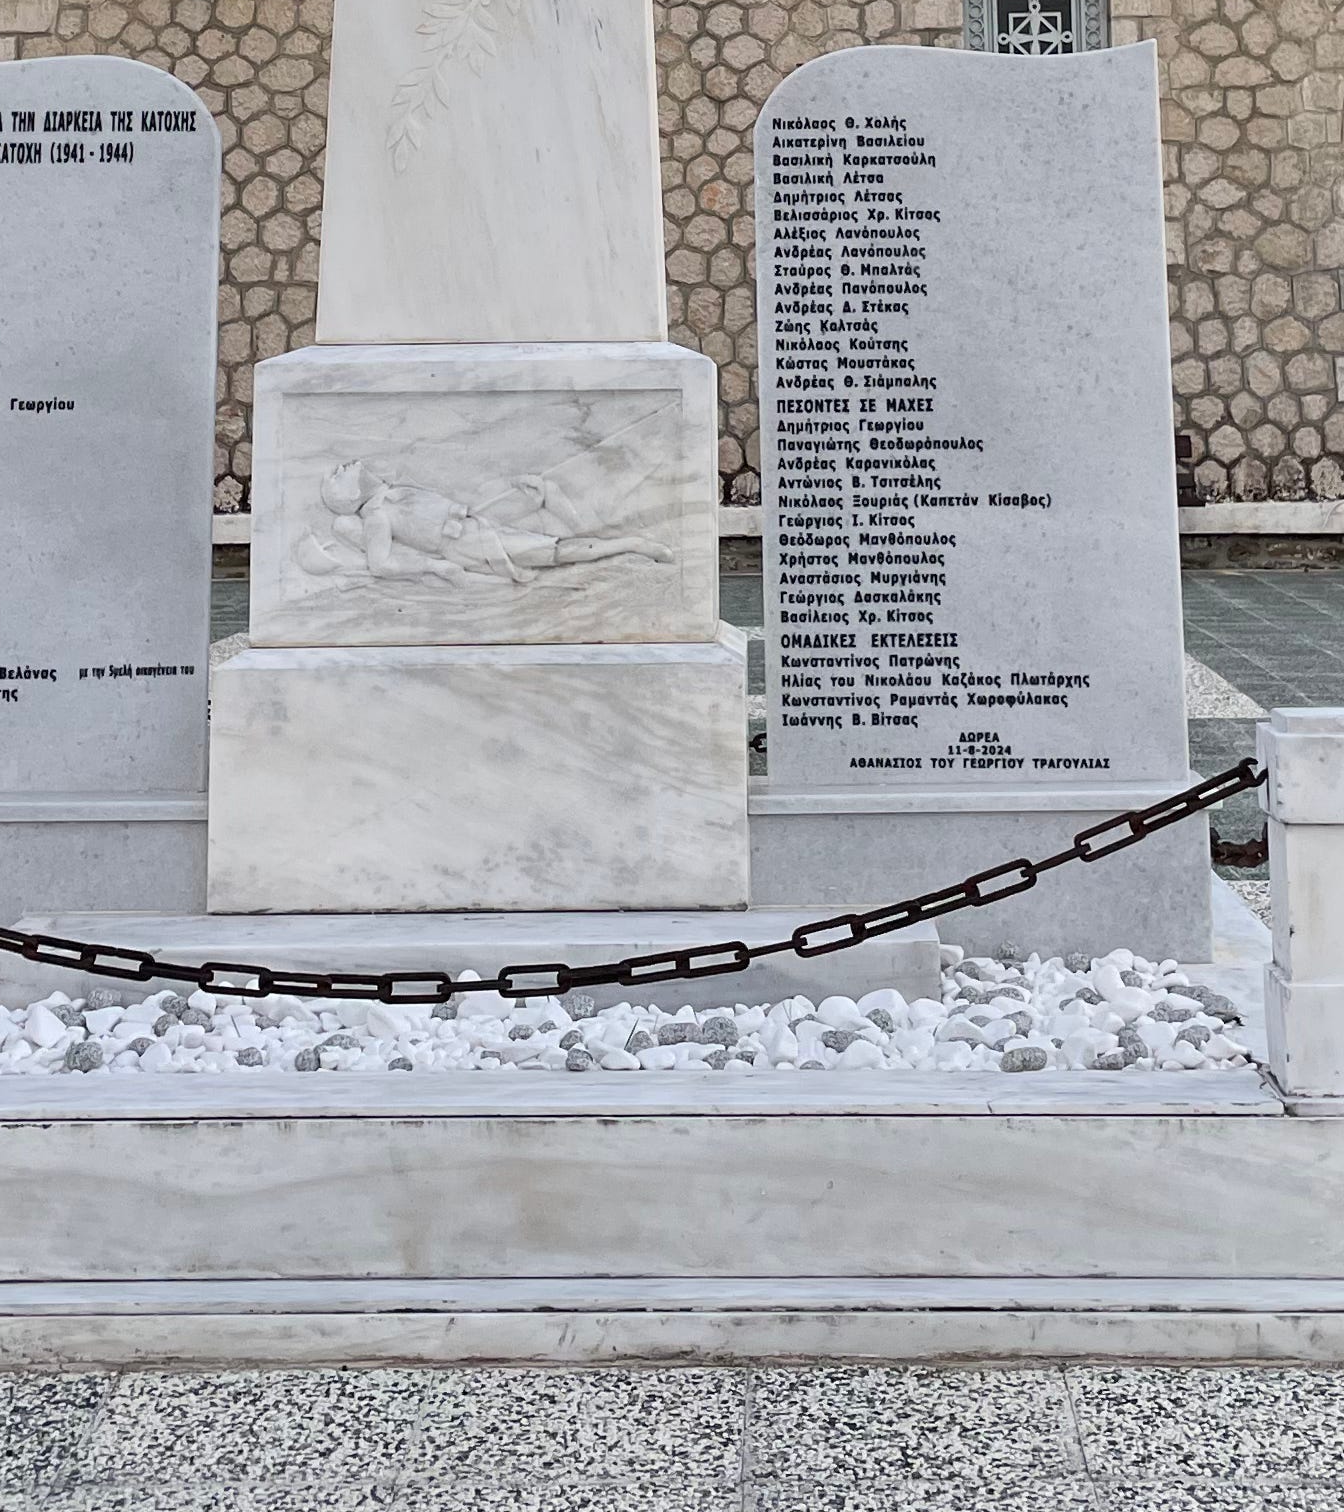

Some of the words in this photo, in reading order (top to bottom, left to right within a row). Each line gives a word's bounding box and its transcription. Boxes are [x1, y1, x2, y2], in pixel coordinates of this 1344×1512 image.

[11, 111, 36, 132] ΤΗΝ
[43, 110, 103, 133] ΔΙΑΡΚΕΙΑ
[110, 110, 134, 132] ΤΗΣ
[141, 110, 197, 133] ΚΑΤΟΧΗΣ
[772, 134, 847, 151] Αικατερίνη
[856, 133, 925, 148] Βασιλείου
[50, 141, 85, 164] (1941
[99, 141, 134, 164] 1944)
[772, 152, 833, 169] Βασιλική
[773, 170, 834, 187] Βασιλική
[773, 189, 845, 206] Δημήτριος
[775, 337, 840, 354] Νικόλαος
[849, 336, 909, 353] Κούτσης
[776, 355, 828, 372] Κώστας
[10, 396, 75, 414] Γεωργίου
[776, 398, 850, 414] ΠΕΣΟΝΤΕΣ
[859, 398, 877, 413] ΣΕ
[886, 397, 934, 413] ΜΑΧΕΣ
[776, 417, 850, 435] Δημήτριος
[858, 416, 924, 434] Γεωργίου
[777, 436, 861, 454] Παναγιώτης
[869, 435, 984, 453] Θεοδωρόπουλος
[778, 474, 843, 492] Αντώνιος
[851, 475, 866, 489] Β.
[778, 493, 844, 511] Νικόλαος
[778, 531, 850, 549] Θεόδωρος
[859, 531, 957, 548] Μανθόπουλος
[779, 551, 839, 569] Χρήστος
[848, 550, 945, 567] Μανθόπουλος
[779, 570, 862, 587] Αναστάσιος
[780, 589, 845, 607] Γεώργιος
[854, 588, 941, 606] Δασκαλάκης
[780, 633, 857, 649] ΟΜΑΔΙΚΕΣ
[871, 632, 958, 648] ΕΚΤΕΛΕΣΕΙΣ
[781, 653, 880, 670] Κωνσταντίνος
[91, 667, 106, 680] την
[180, 665, 195, 675] του
[781, 672, 822, 690] Ηλίας
[830, 676, 855, 688] του
[864, 672, 932, 687] Νικολάου
[1010, 671, 1090, 689] Πλωτάρχης
[781, 692, 881, 710] Κωνσταντίνος
[782, 712, 843, 730] Ιωάννης
[852, 713, 866, 726] Β.
[958, 731, 1000, 743] ΔΩΡΕΑ
[948, 745, 1012, 756] 11-8-2024
[849, 757, 922, 769] ΑΘΑΝΑΣΙΟΣ
[930, 757, 955, 769] ΤΟΥ
[963, 757, 1025, 769] ΓΕΩΡΓΙΟΥ
[1031, 758, 1111, 769] ΤΡΑΓΟΥΛΙΑΣ
